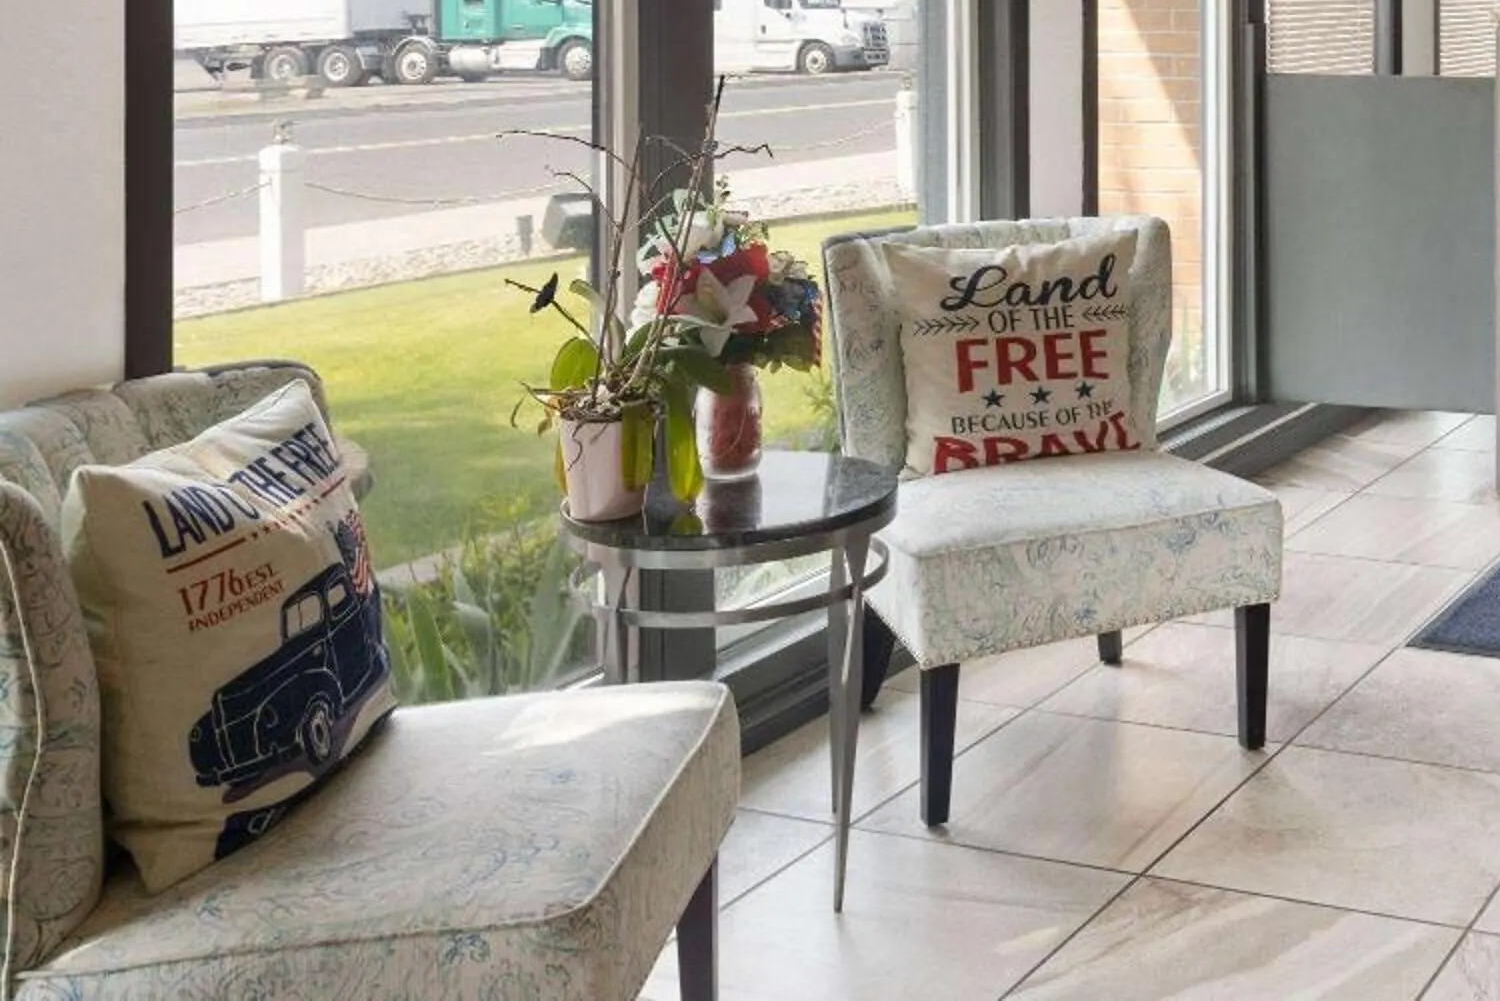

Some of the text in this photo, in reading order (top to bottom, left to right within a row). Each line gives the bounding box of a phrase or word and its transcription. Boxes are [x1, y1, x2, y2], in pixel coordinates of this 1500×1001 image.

[940, 253, 1118, 312] Land
[988, 304, 1075, 334] OF THE
[955, 330, 1110, 393] FREE
[951, 410, 1050, 435] BECAUSE
[1055, 406, 1082, 426] OF
[142, 485, 235, 559] LAND
[228, 457, 306, 508] THE
[269, 422, 341, 486] FREE
[179, 568, 244, 616] 1776
